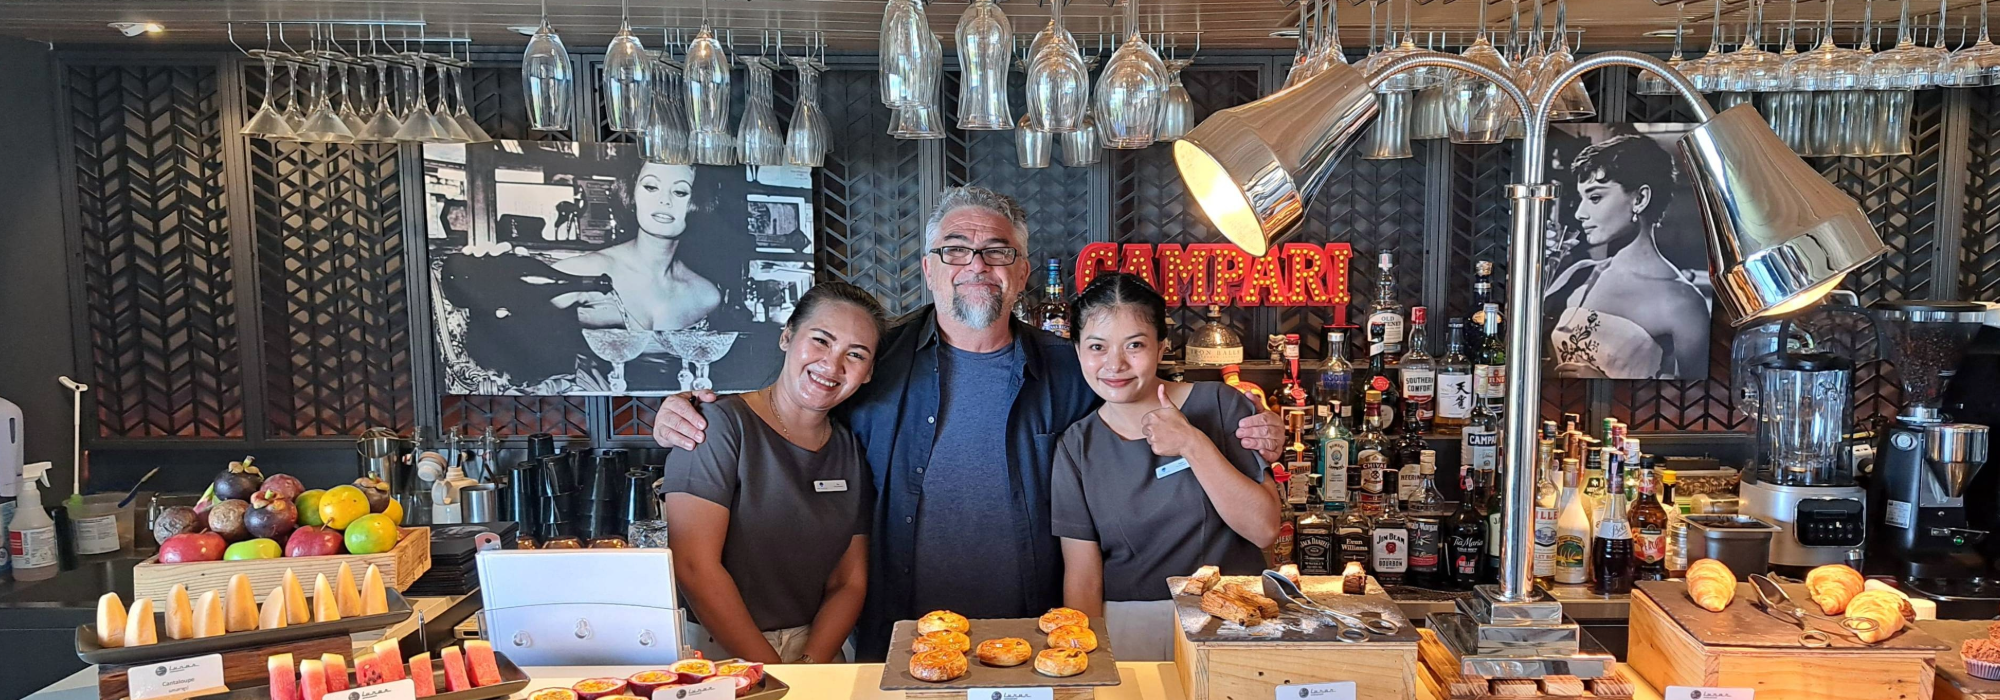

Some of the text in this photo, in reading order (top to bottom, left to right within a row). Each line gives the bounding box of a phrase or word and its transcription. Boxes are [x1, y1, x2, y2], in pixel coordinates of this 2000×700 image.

[1075, 243, 1354, 306] CAMPARI
[1469, 435, 1496, 445] CAMPA
[162, 677, 195, 687] Cantaloupe
